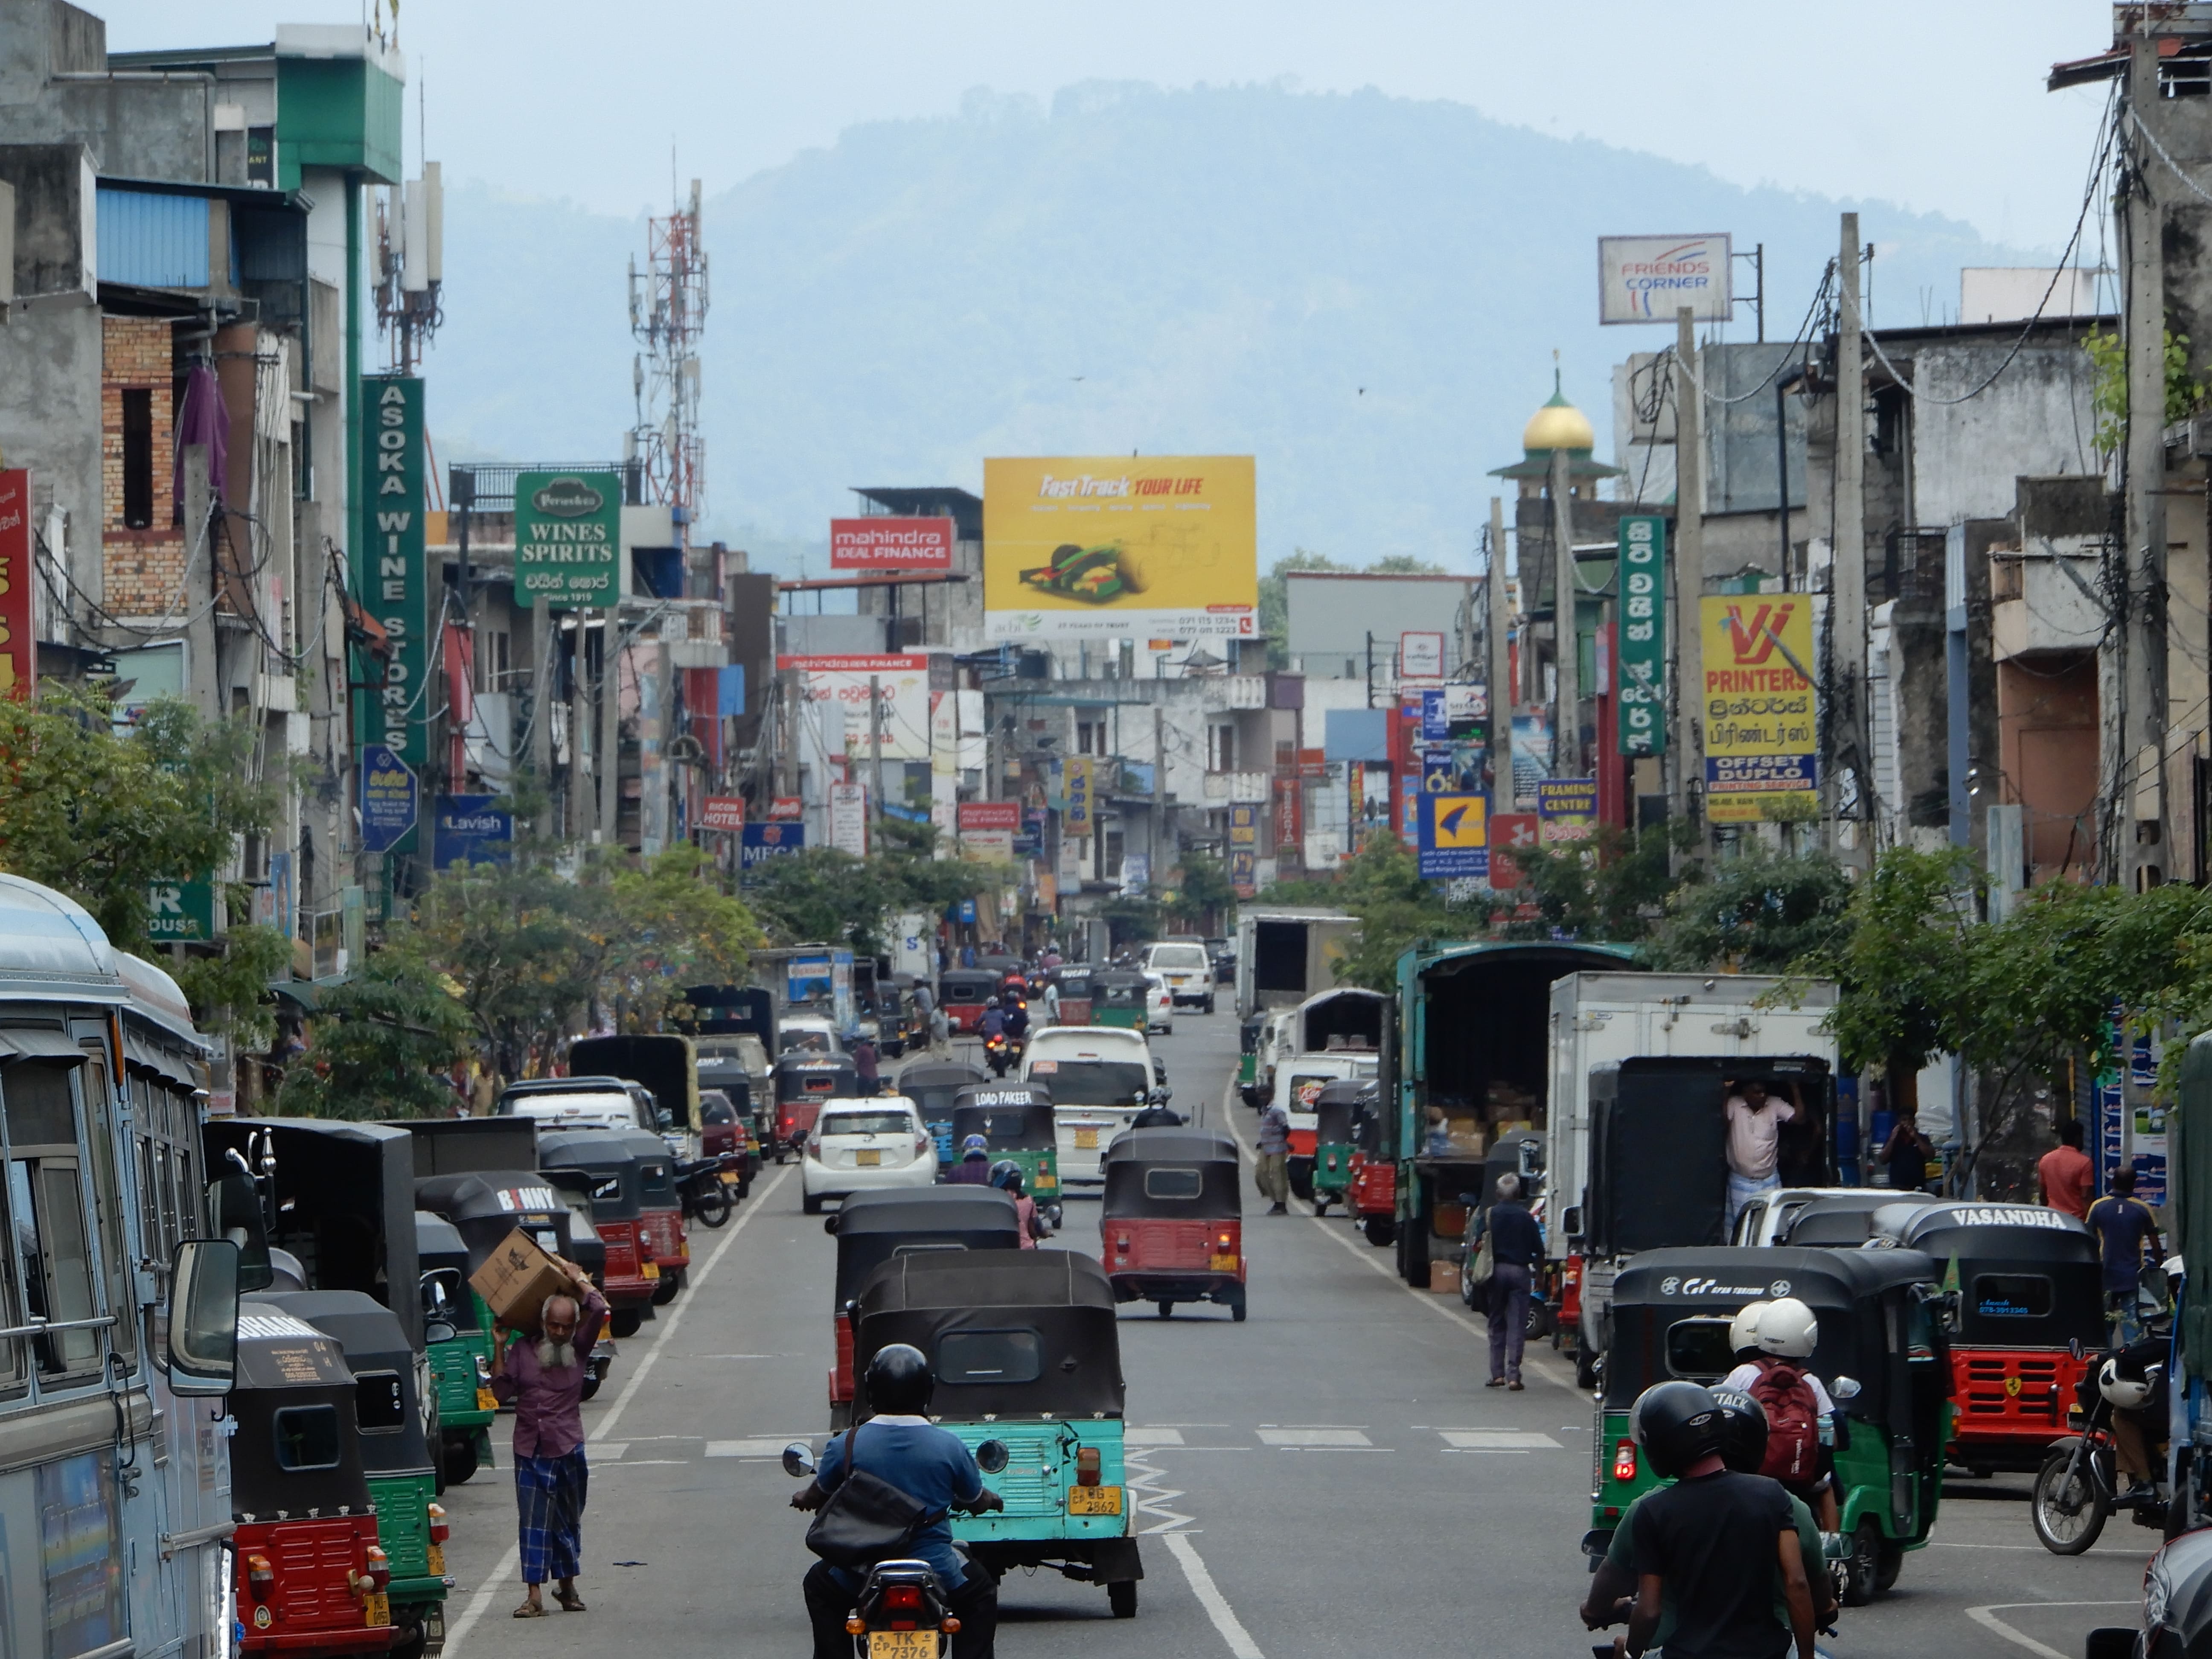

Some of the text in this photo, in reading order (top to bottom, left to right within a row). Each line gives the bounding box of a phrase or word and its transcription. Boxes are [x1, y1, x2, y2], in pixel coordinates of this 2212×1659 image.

[1621, 261, 1710, 275] FRIENDS
[1626, 277, 1708, 289] CORNER
[379, 386, 406, 495] ASOKA
[1039, 474, 1203, 498] Fast Track YOUR LIFE
[530, 523, 606, 541] WINES
[835, 530, 941, 544] mahindra
[378, 512, 410, 601] WINE
[522, 543, 613, 562] SPIRITS
[835, 546, 946, 559] IDEAL FINANCE
[381, 617, 407, 751] STORES
[1706, 669, 1808, 694] PRINTERS
[1716, 756, 1804, 768] OFFSET
[1718, 768, 1802, 781] DUPLO
[1540, 783, 1595, 796] FRAMING
[1545, 798, 1592, 810] CENTRE
[448, 815, 501, 830] Lavish
[704, 812, 742, 825] HOTEL
[976, 1091, 1032, 1106] LOAD PAKEER
[497, 1187, 555, 1211] BENNY
[1951, 1208, 2067, 1230] VASANDHA
[1086, 1501, 1115, 1513] 2862
[894, 1632, 915, 1645] TK
[873, 1642, 890, 1651] CP
[891, 1647, 928, 1659] 7376
